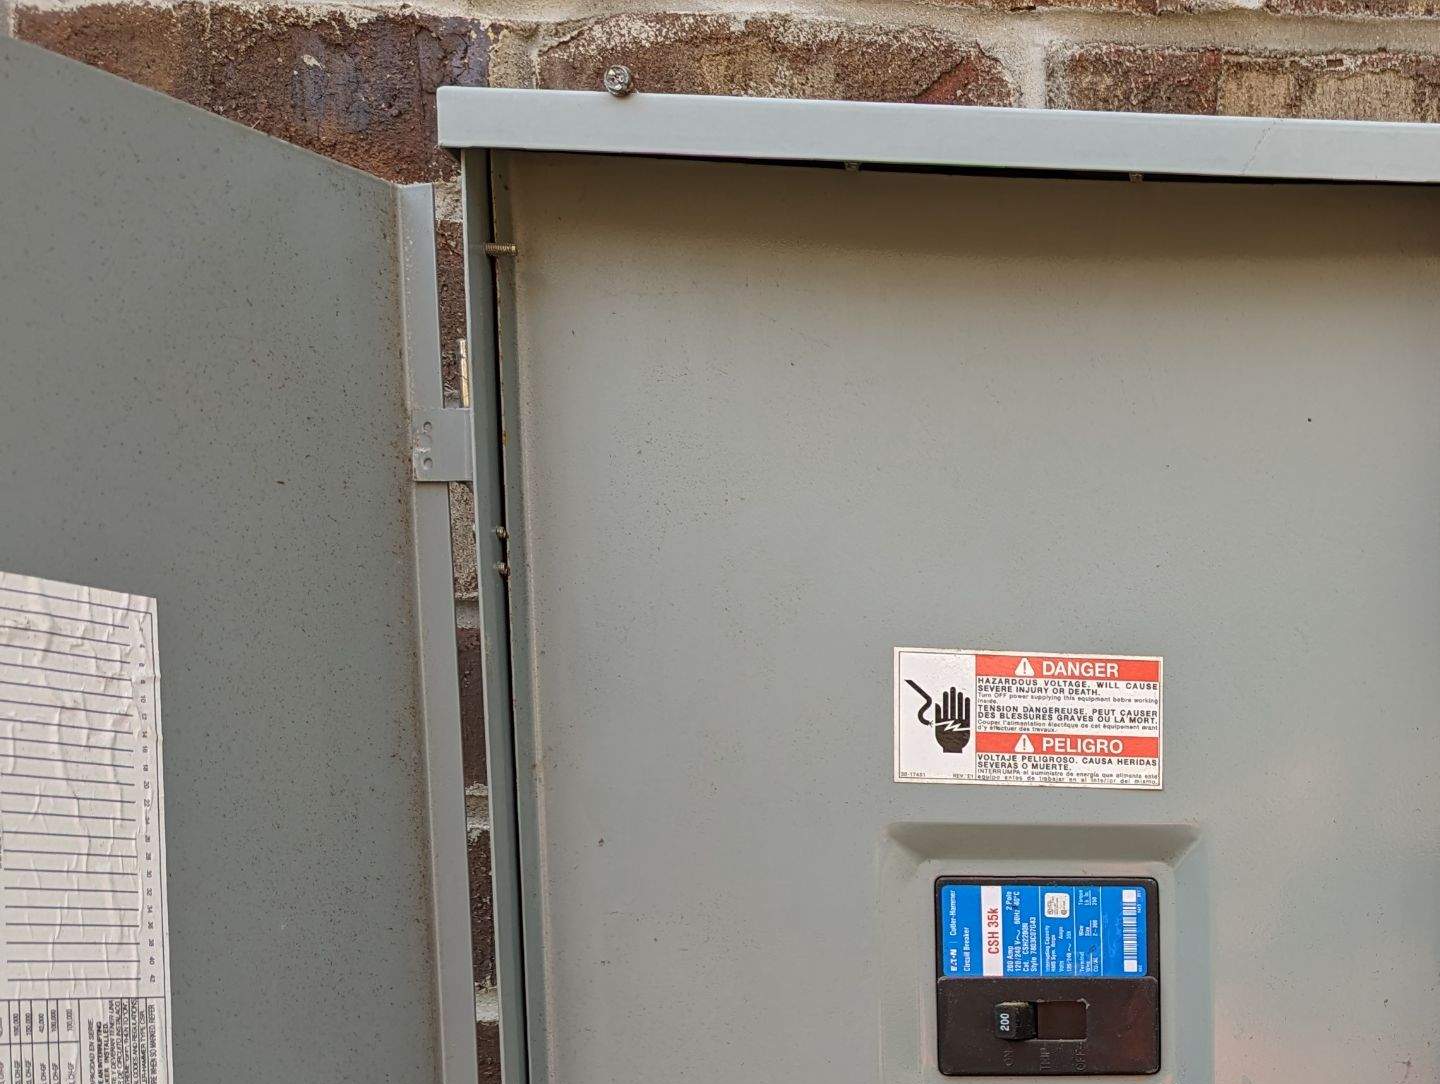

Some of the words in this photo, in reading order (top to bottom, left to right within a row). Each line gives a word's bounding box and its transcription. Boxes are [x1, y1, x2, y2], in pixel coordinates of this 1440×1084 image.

[1042, 661, 1119, 678] DANGER
[978, 678, 1038, 686] HAZARDOUS
[1044, 680, 1090, 688] VOLTAGE.
[1096, 681, 1119, 689] WILL
[977, 685, 1013, 693] SEVERE
[1016, 686, 1048, 694] INJURY
[1068, 688, 1100, 696] DEATH.
[1023, 706, 1087, 715] DANGEREUSE.
[1092, 708, 1115, 716] PEUT
[1120, 709, 1157, 718] CAUSER
[1000, 713, 1053, 721] BLESSURES
[1057, 714, 1094, 722] GRAVES
[1129, 716, 1157, 724] MORT.
[1042, 737, 1123, 754] PELIGRO
[977, 754, 1017, 762] VOLTAJE
[1021, 755, 1078, 764] PELIGROSO.
[1082, 757, 1113, 765] CAUSA
[1117, 758, 1157, 767] HERIDAS
[977, 761, 1018, 769] SEVERAS
[1031, 763, 1072, 771] MUERTE.
[144, 799, 150, 807] 22
[147, 887, 152, 896] 32
[987, 908, 999, 928] 35k
[987, 932, 999, 954] CSH
[149, 956, 155, 965] 40
[150, 974, 155, 982] 42
[1000, 1013, 1010, 1031] 200
